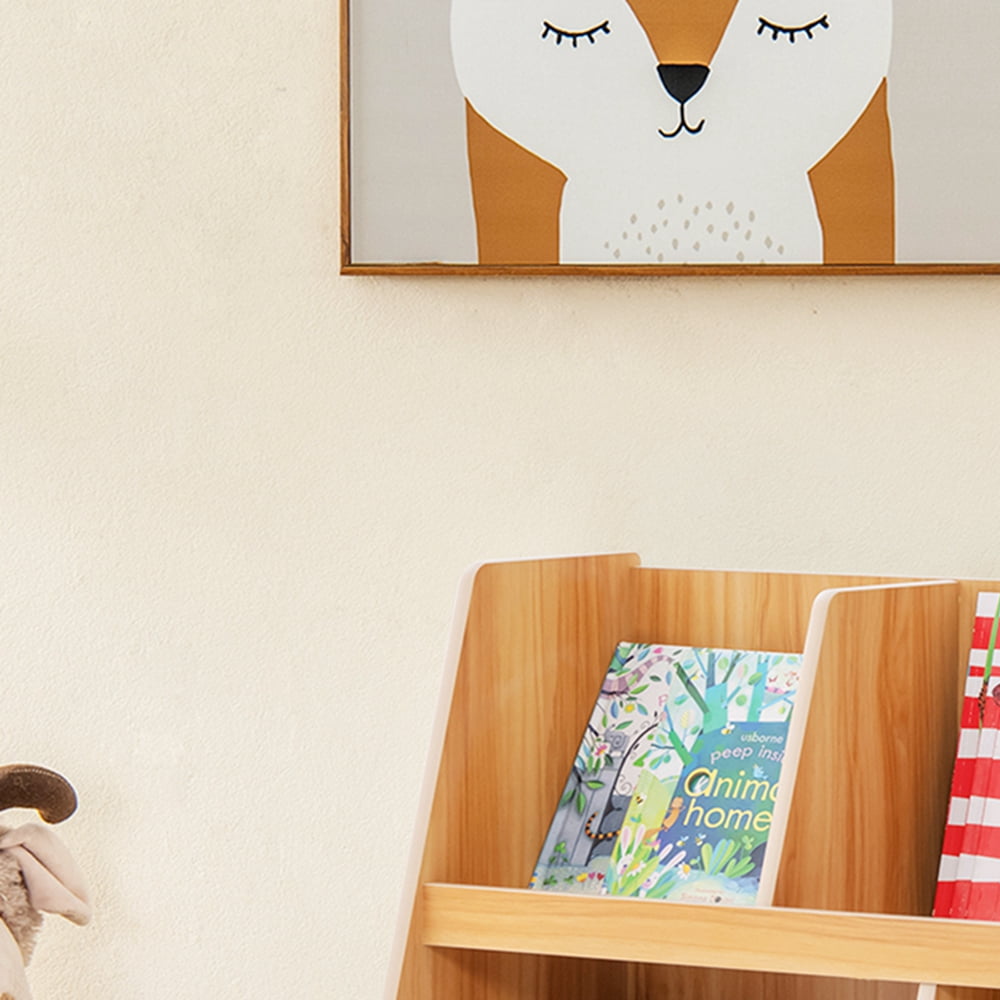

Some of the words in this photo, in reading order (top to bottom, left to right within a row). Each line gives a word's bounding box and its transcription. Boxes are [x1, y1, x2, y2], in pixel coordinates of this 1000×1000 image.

[740, 731, 784, 743] usborne
[710, 747, 753, 765] peep
[683, 798, 773, 832] home
